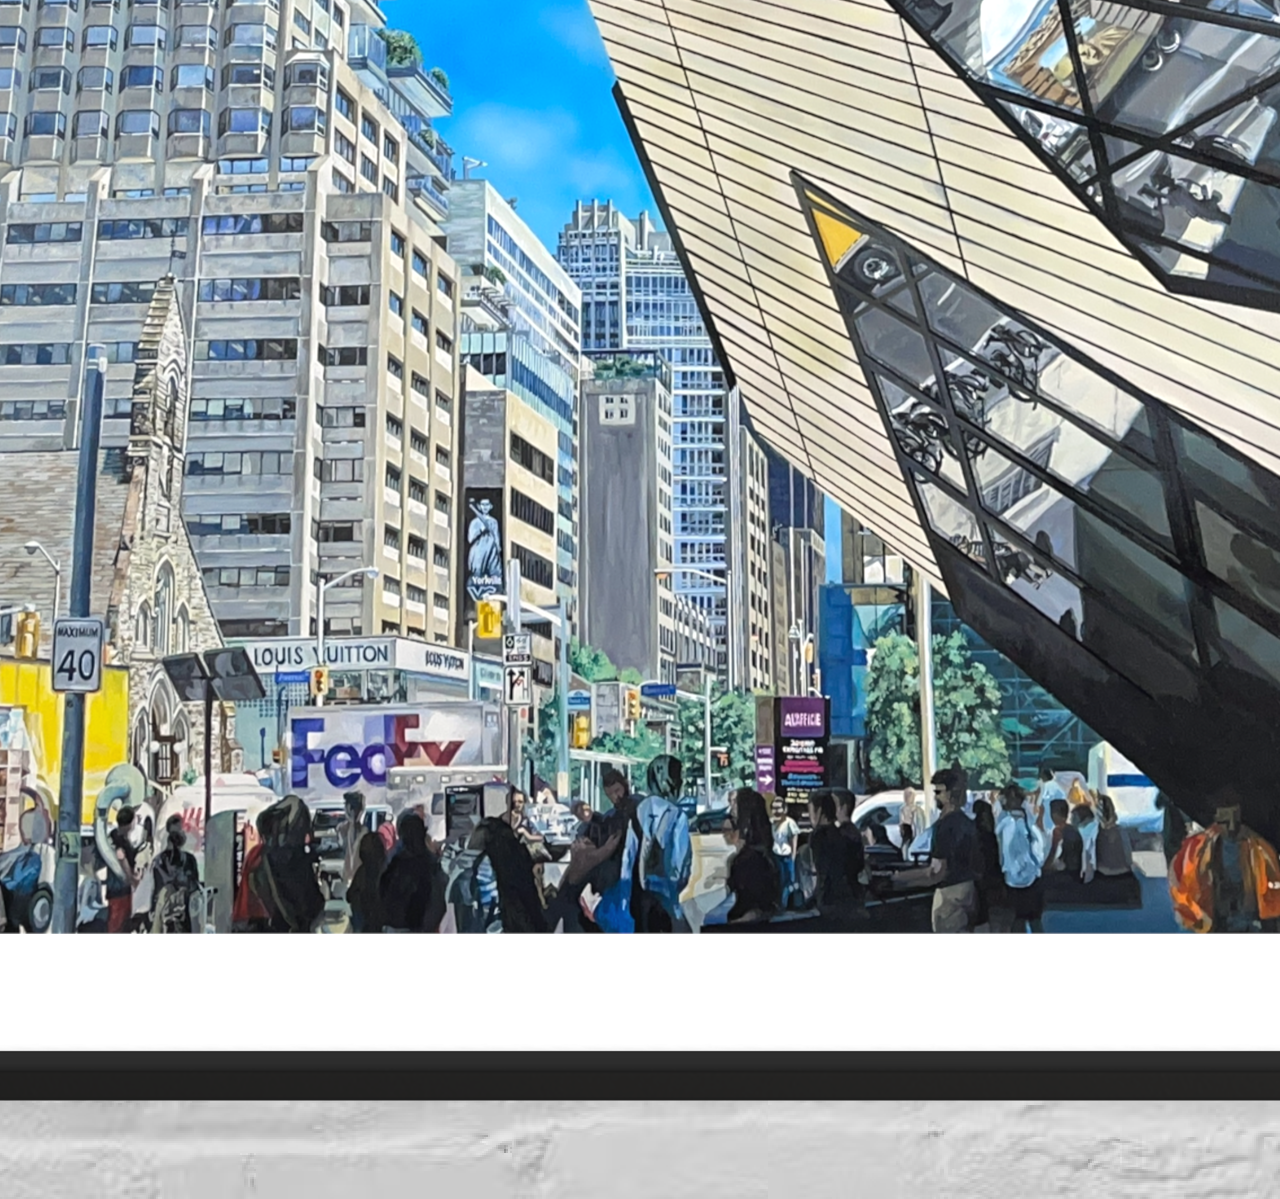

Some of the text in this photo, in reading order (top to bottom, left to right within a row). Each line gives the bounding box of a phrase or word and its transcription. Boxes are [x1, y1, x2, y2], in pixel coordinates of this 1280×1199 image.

[57, 626, 99, 638] MAXIMUM
[57, 650, 96, 682] 40
[254, 646, 303, 667] LOUIS
